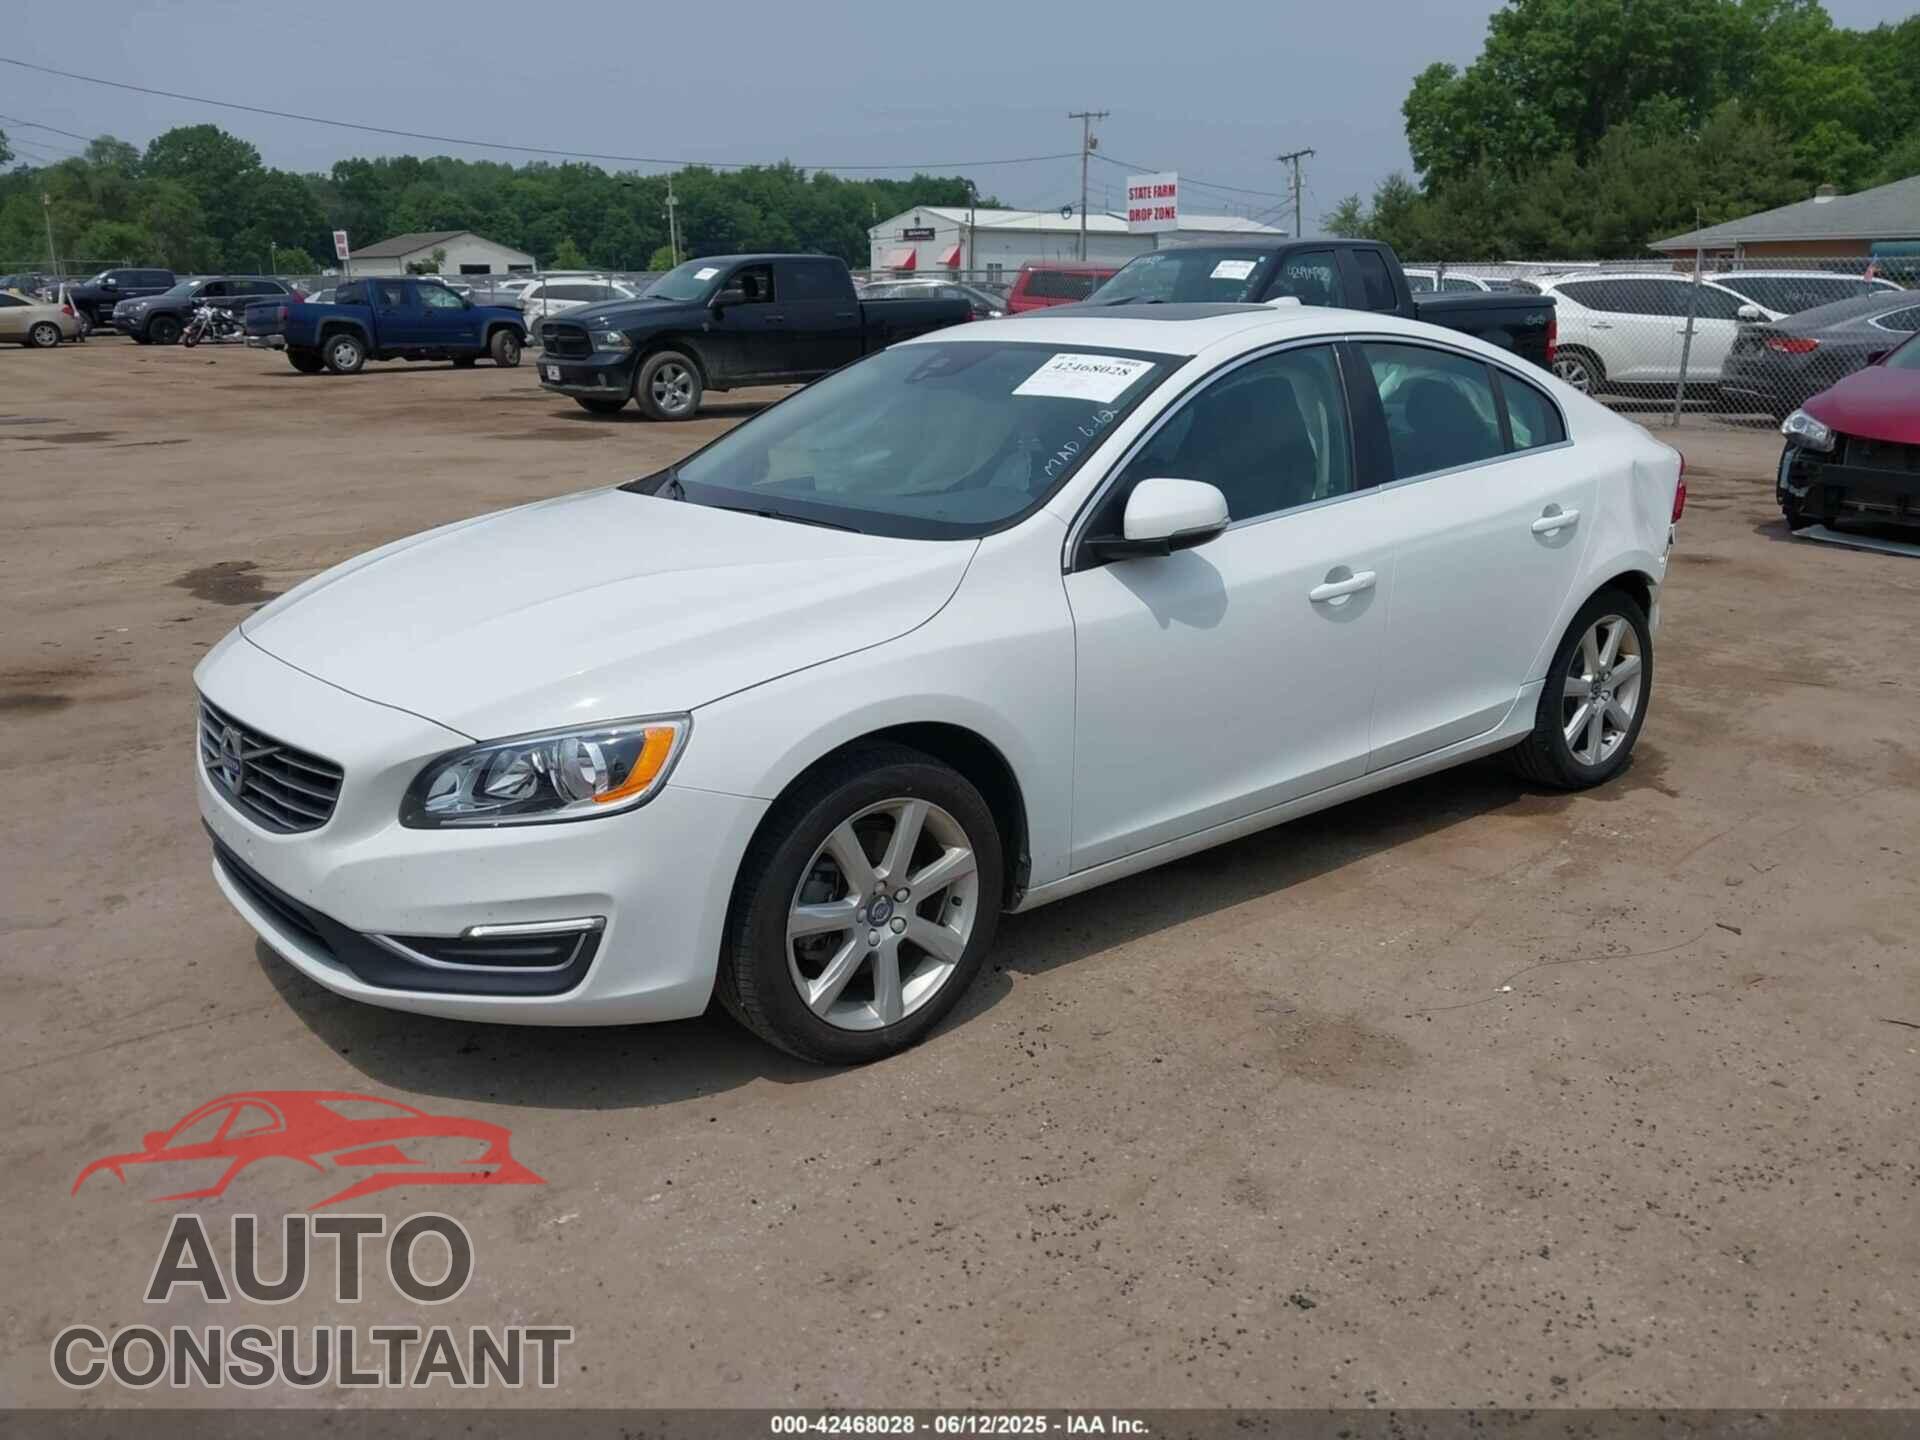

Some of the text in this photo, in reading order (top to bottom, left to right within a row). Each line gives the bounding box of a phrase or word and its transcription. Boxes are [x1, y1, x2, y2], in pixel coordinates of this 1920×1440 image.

[1128, 184, 1176, 201] STATE FARM
[1129, 206, 1176, 222] DROP ZONE
[1052, 361, 1132, 377] 42468028
[1044, 440, 1080, 476] MAD
